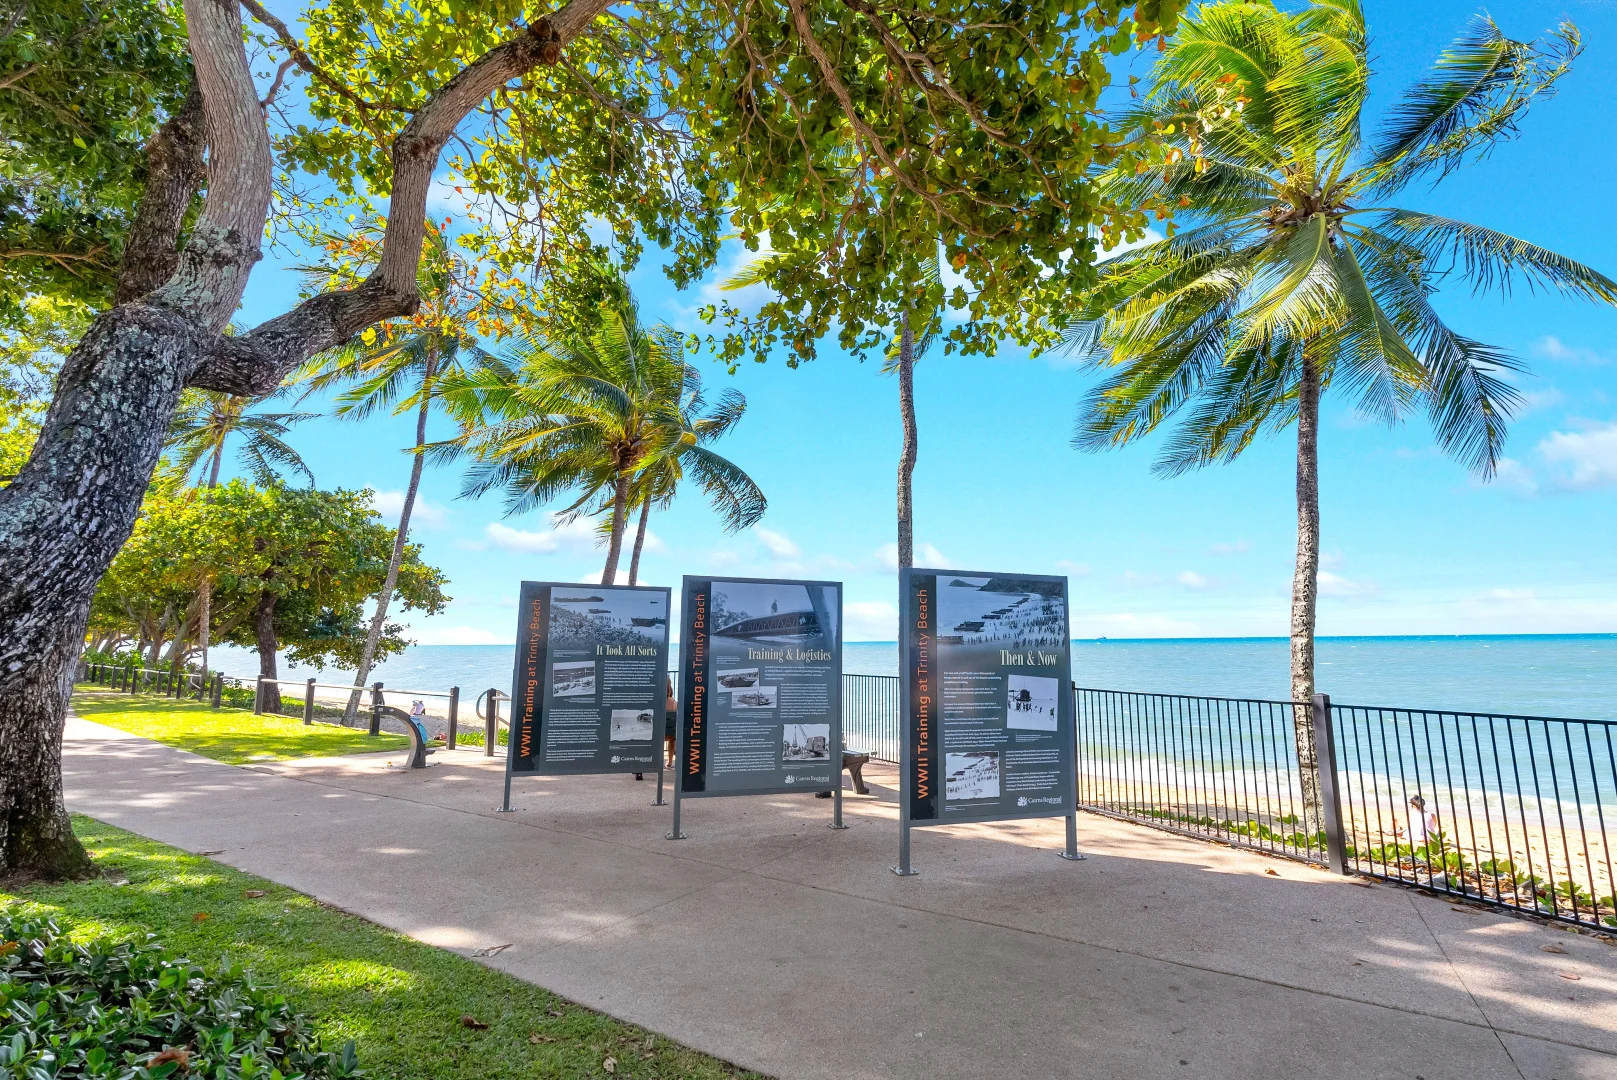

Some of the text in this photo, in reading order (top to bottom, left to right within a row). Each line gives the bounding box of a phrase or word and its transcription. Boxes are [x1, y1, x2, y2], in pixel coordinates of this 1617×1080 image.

[520, 599, 541, 758] WWII Training at Trinity Beach
[596, 645, 603, 656] It
[606, 645, 623, 656] Took
[625, 645, 636, 656] All
[638, 646, 657, 656] Sorts
[689, 594, 706, 775] WWII Training at Trinity Beach
[748, 647, 784, 663] Training
[786, 649, 794, 660] &
[796, 648, 832, 663] Logistics
[916, 589, 932, 799] WWII Training at Trinity Beach
[1000, 650, 1057, 666] Then & Now
